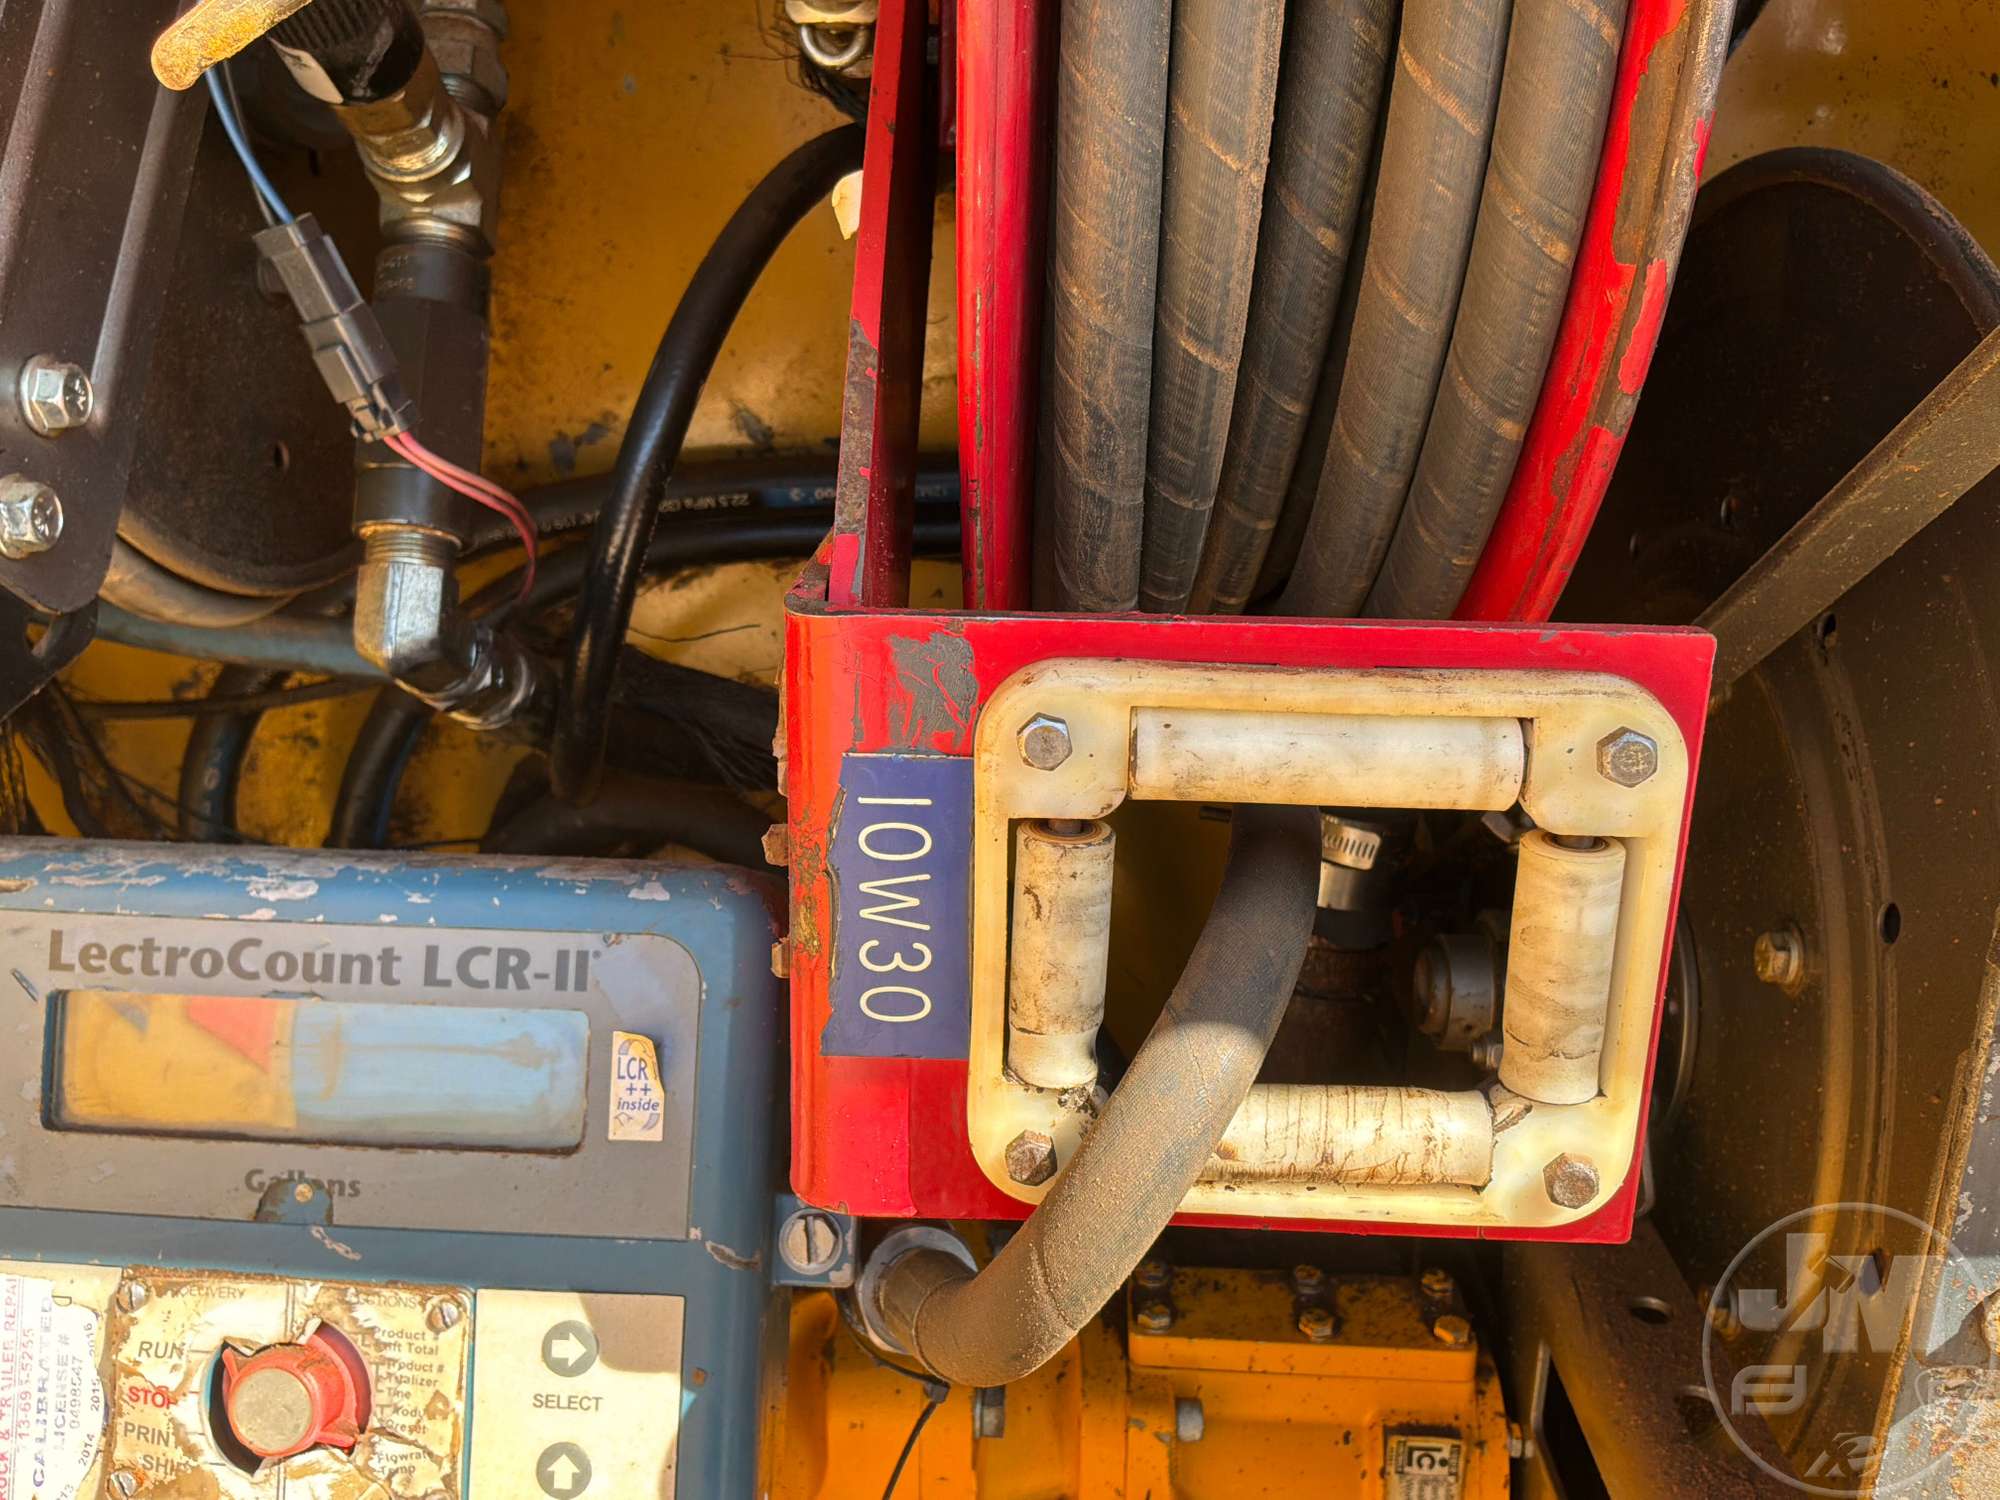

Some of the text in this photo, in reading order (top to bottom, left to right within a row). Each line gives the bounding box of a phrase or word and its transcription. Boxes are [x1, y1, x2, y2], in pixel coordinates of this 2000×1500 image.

[857, 797, 932, 1022] 10W30
[48, 929, 589, 992] LectroCount LCR-II
[617, 1056, 649, 1080] LCR
[617, 1097, 660, 1111] inside
[137, 1340, 185, 1360] RUN
[406, 1341, 439, 1356] Total
[532, 1392, 604, 1412] SELECT
